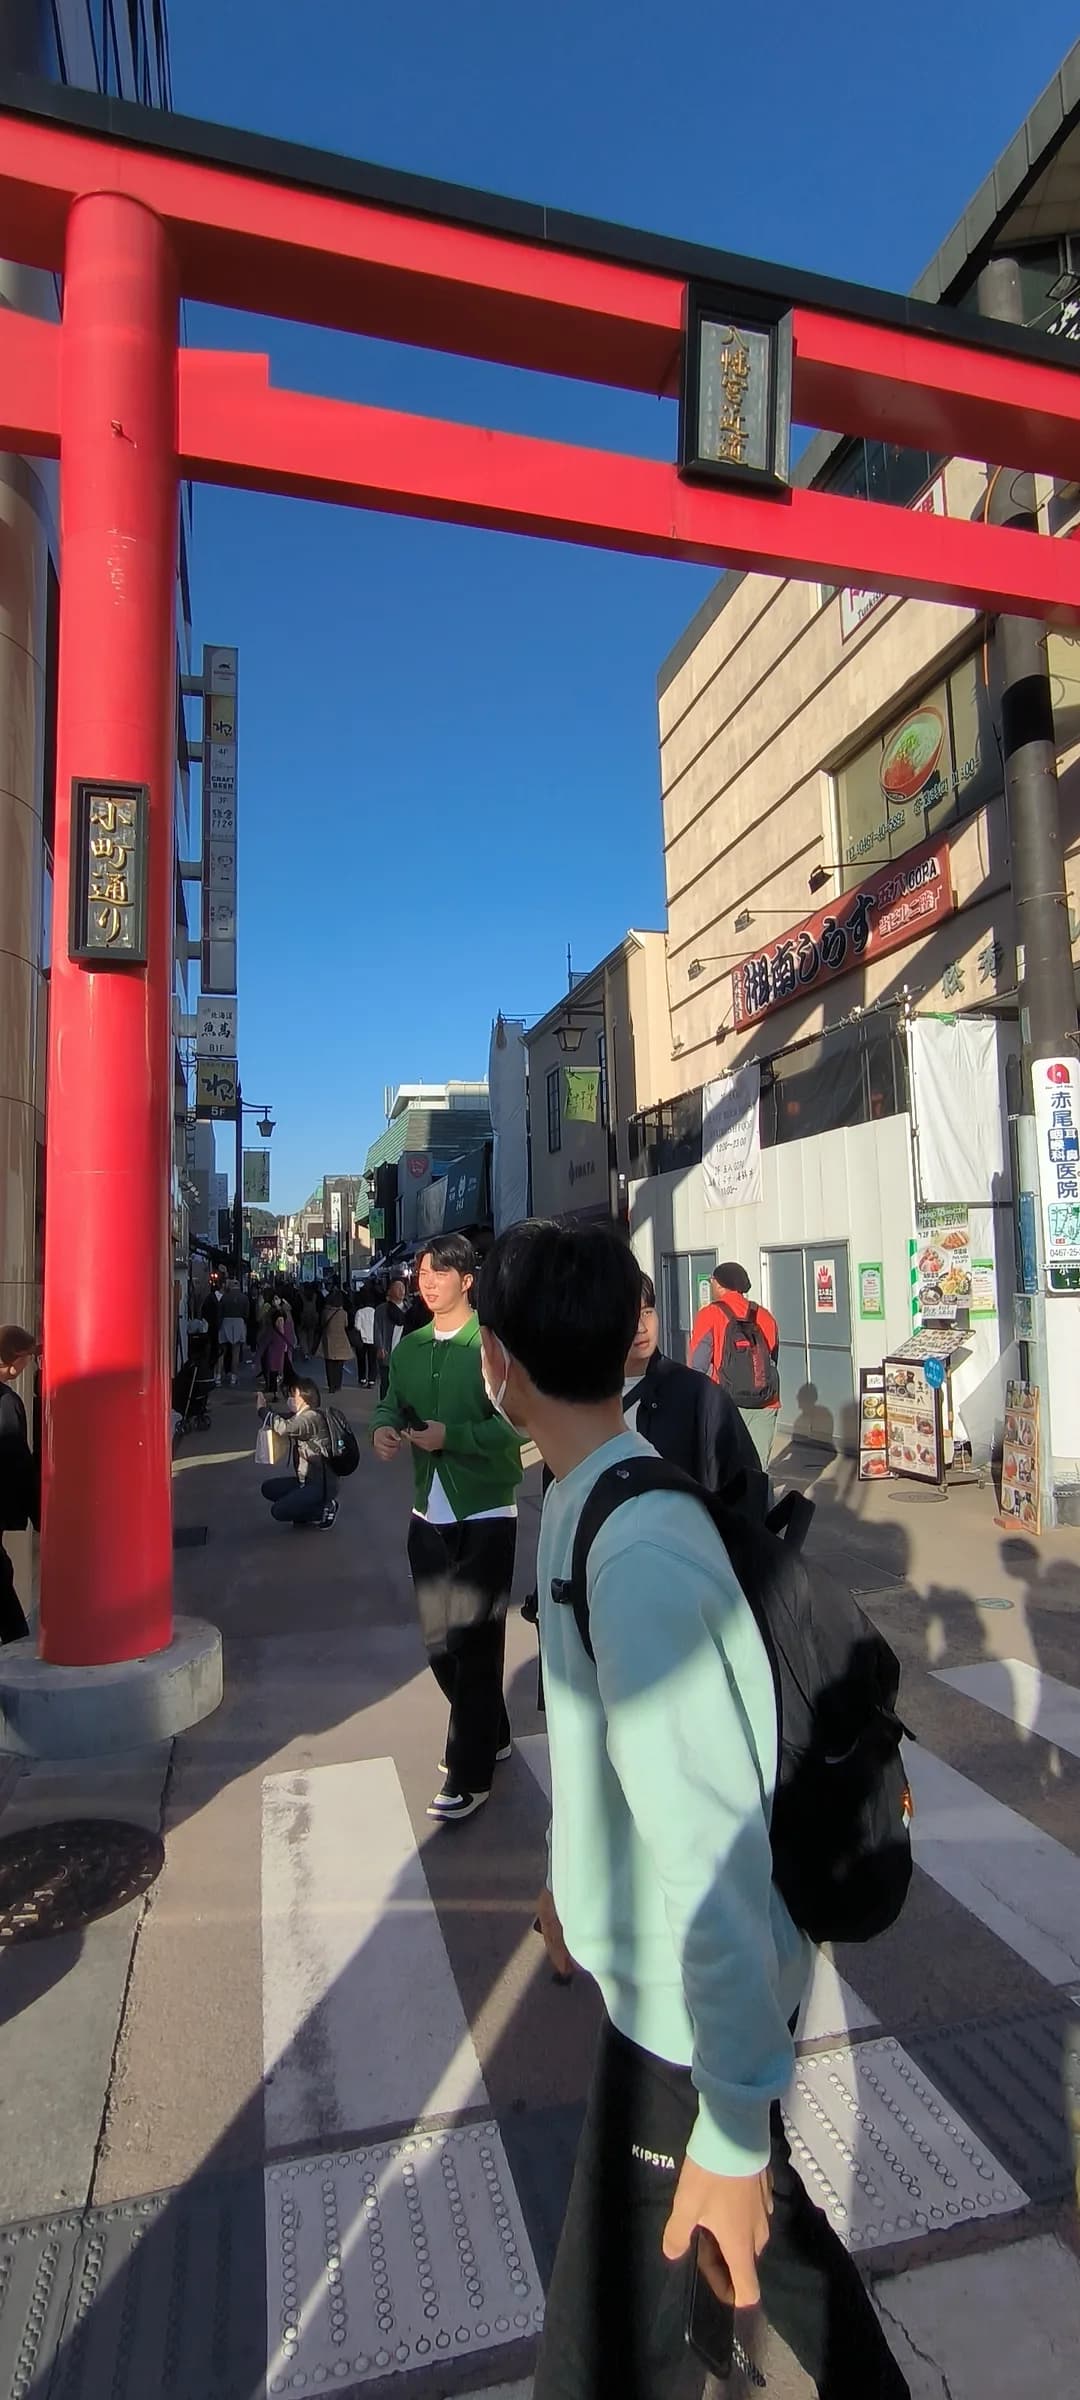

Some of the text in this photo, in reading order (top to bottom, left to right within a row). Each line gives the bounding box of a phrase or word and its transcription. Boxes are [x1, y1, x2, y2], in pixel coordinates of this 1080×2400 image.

[88, 800, 135, 943] 小町通り
[744, 894, 876, 1016] 湘南しらす
[211, 1107, 225, 1116] 5F
[1051, 1091, 1073, 1128] 赤尾
[1056, 1163, 1079, 1199] 医院
[632, 2144, 675, 2169] KIPSTA
